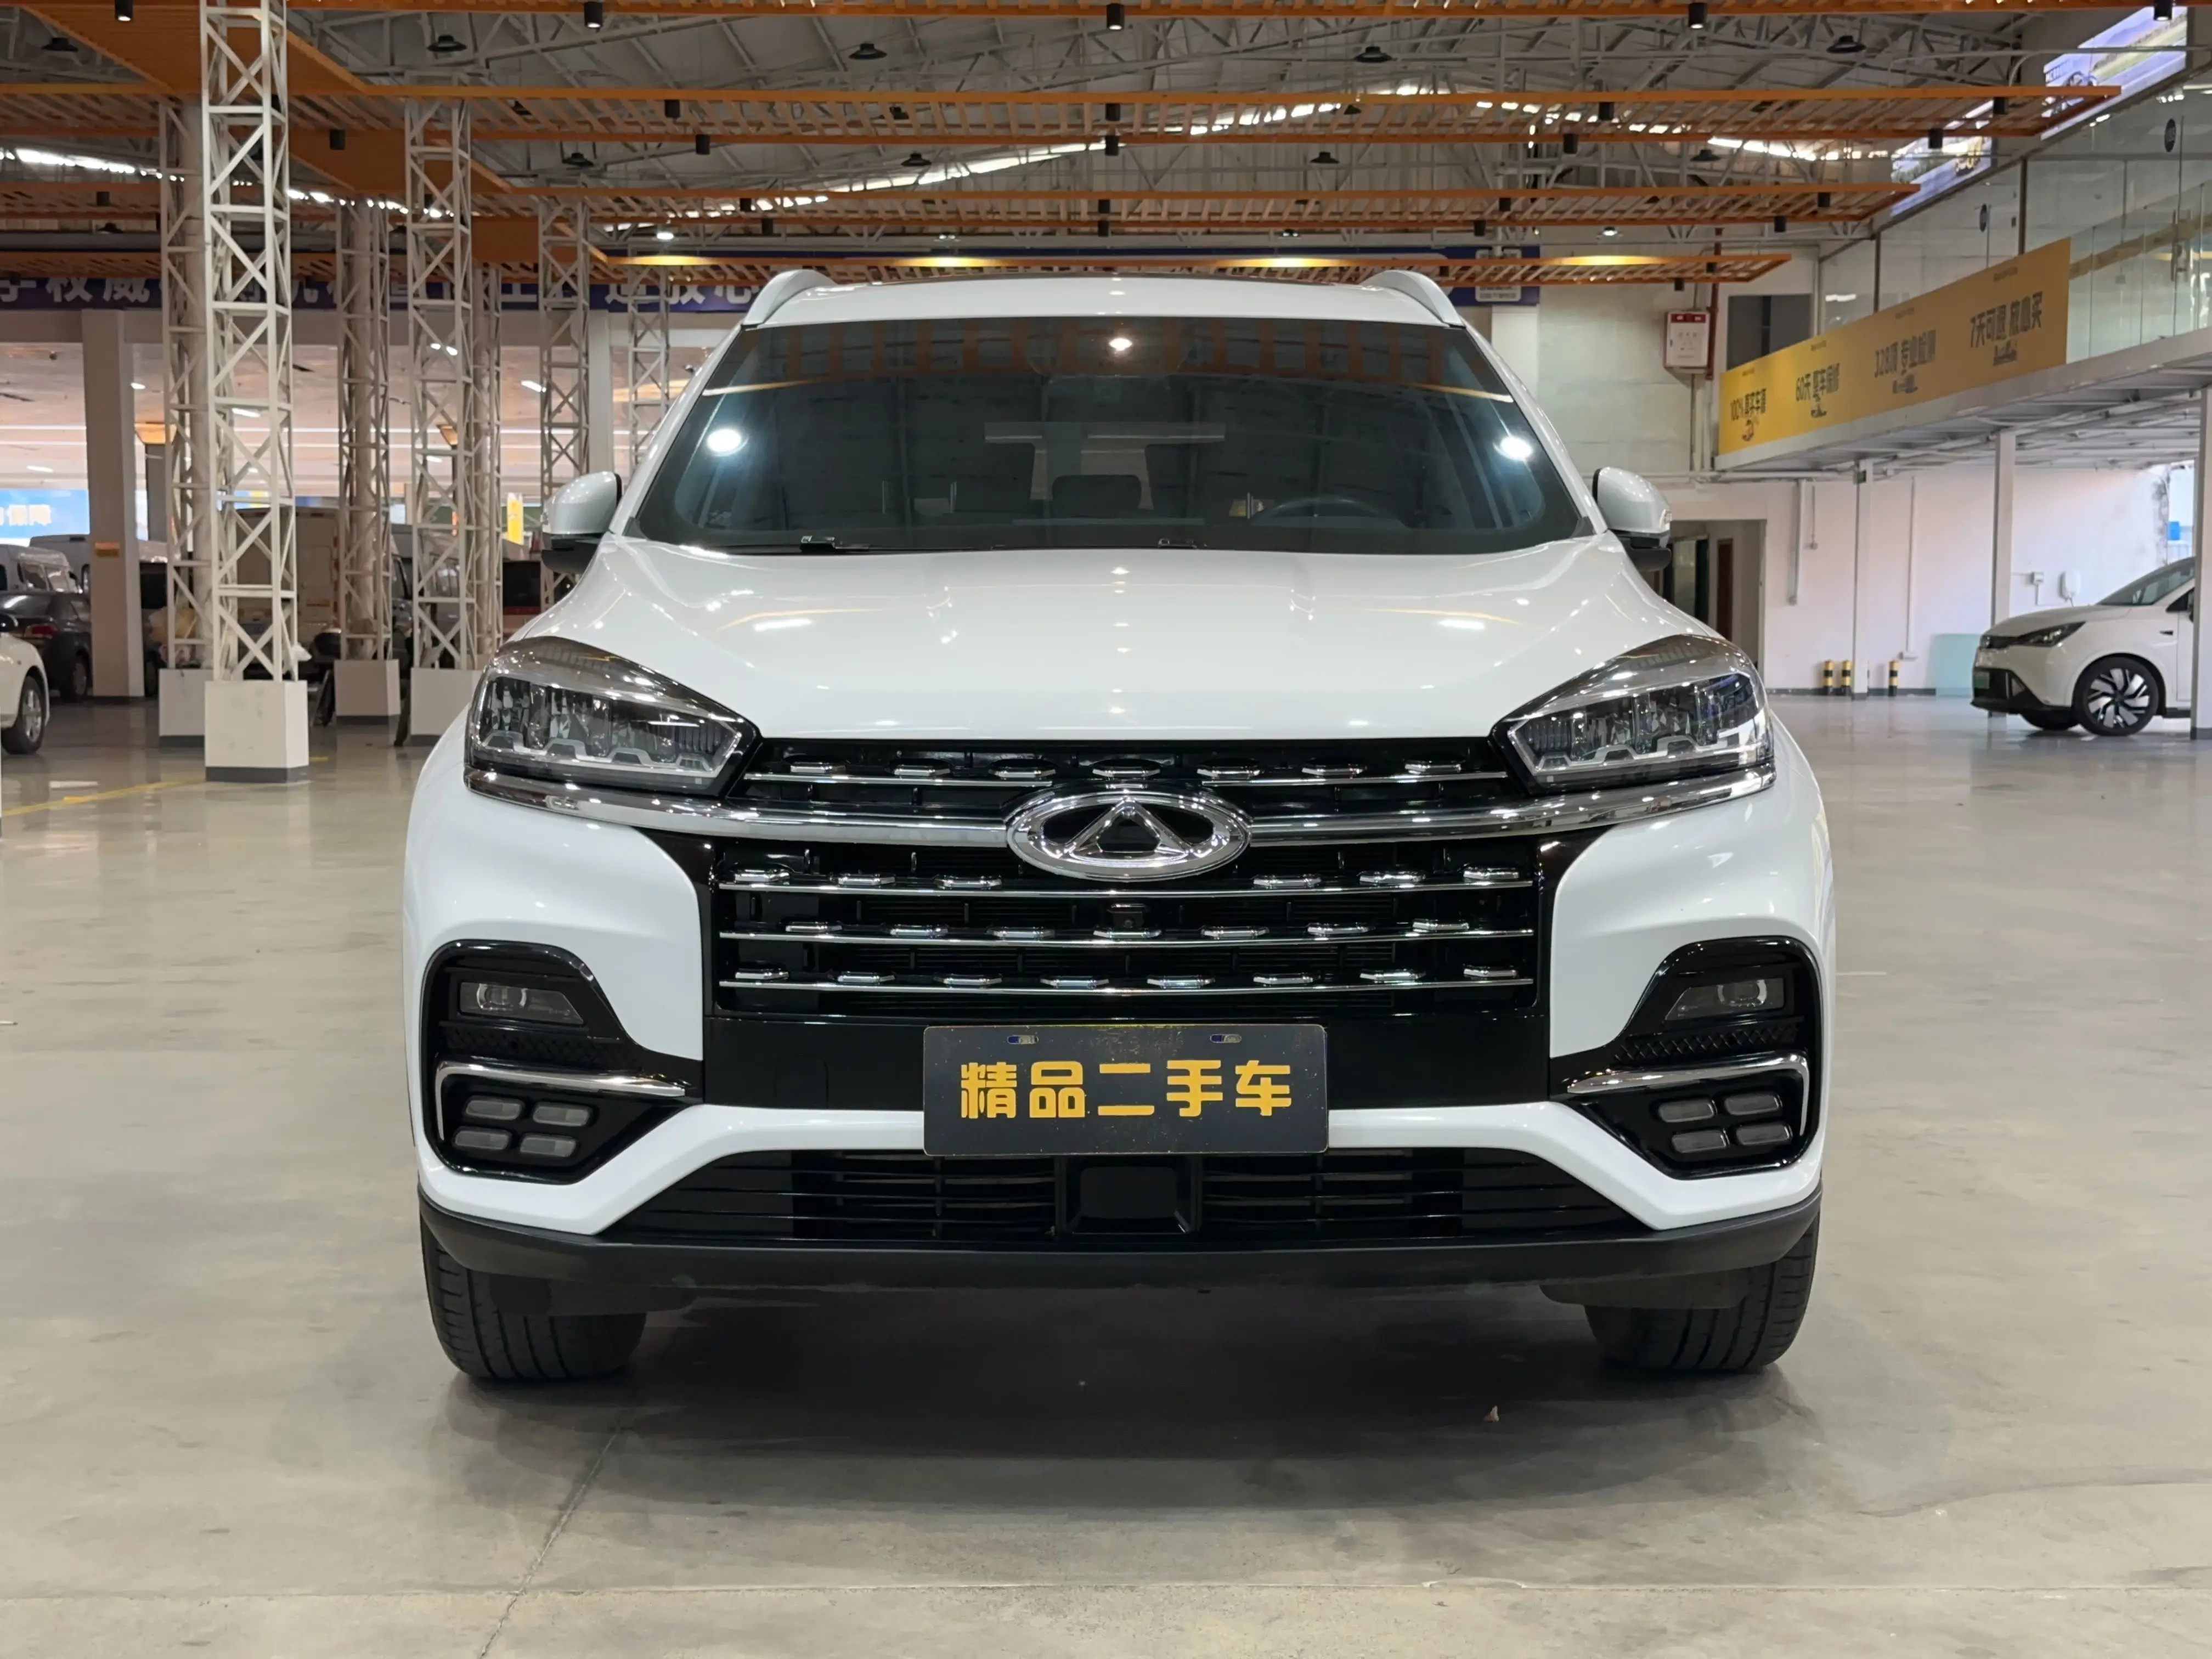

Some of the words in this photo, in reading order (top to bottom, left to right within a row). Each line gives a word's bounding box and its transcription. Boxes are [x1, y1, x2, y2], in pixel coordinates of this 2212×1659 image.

[961, 1060, 1291, 1119] 精品二手车
